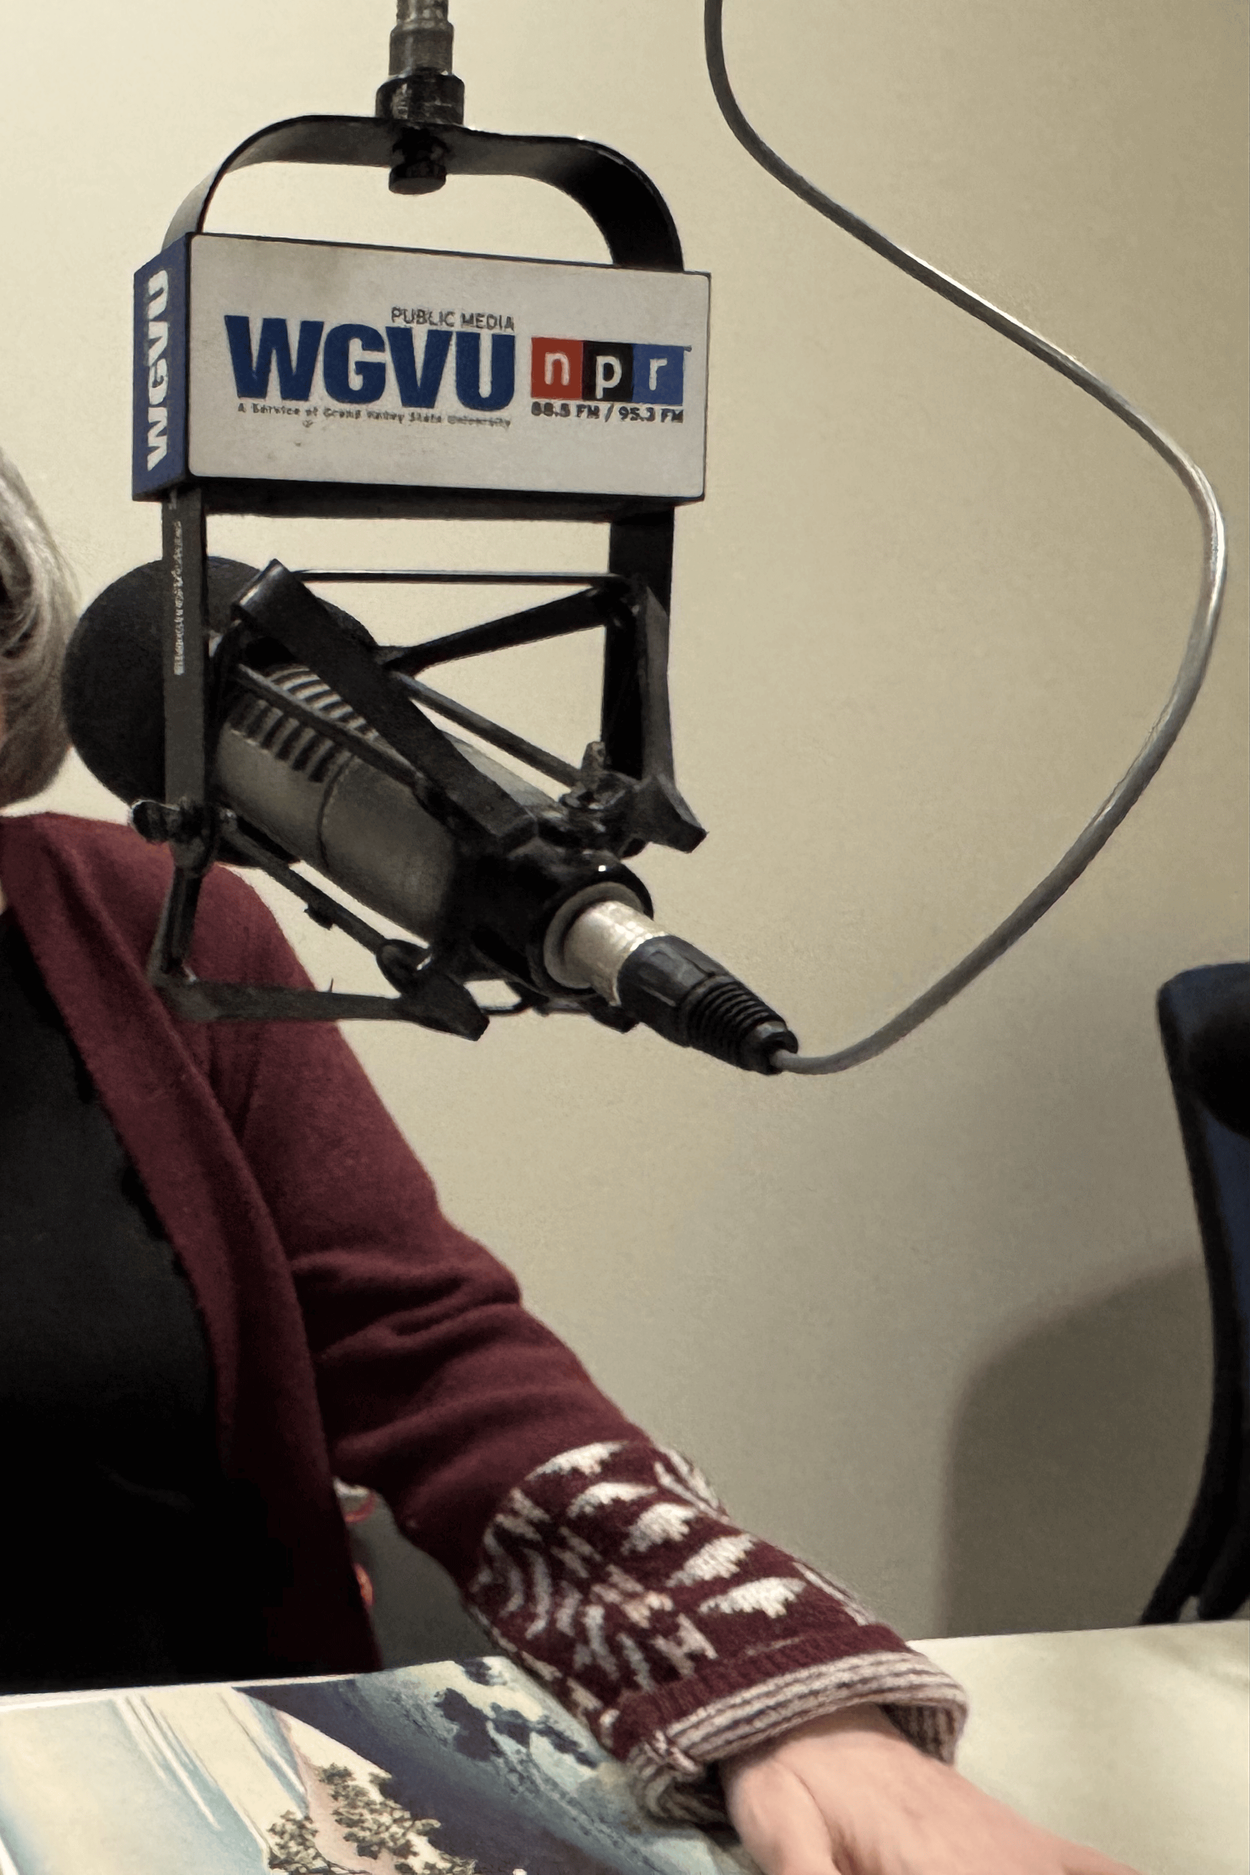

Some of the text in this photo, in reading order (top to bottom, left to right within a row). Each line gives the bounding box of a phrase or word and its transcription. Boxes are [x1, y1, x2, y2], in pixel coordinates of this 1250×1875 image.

[391, 306, 515, 332] PUBLIC MEDIA
[147, 269, 169, 472] WGVU
[224, 315, 516, 411] WGVU
[543, 351, 669, 400] npr
[576, 404, 600, 419] FM
[660, 408, 684, 424] FM
